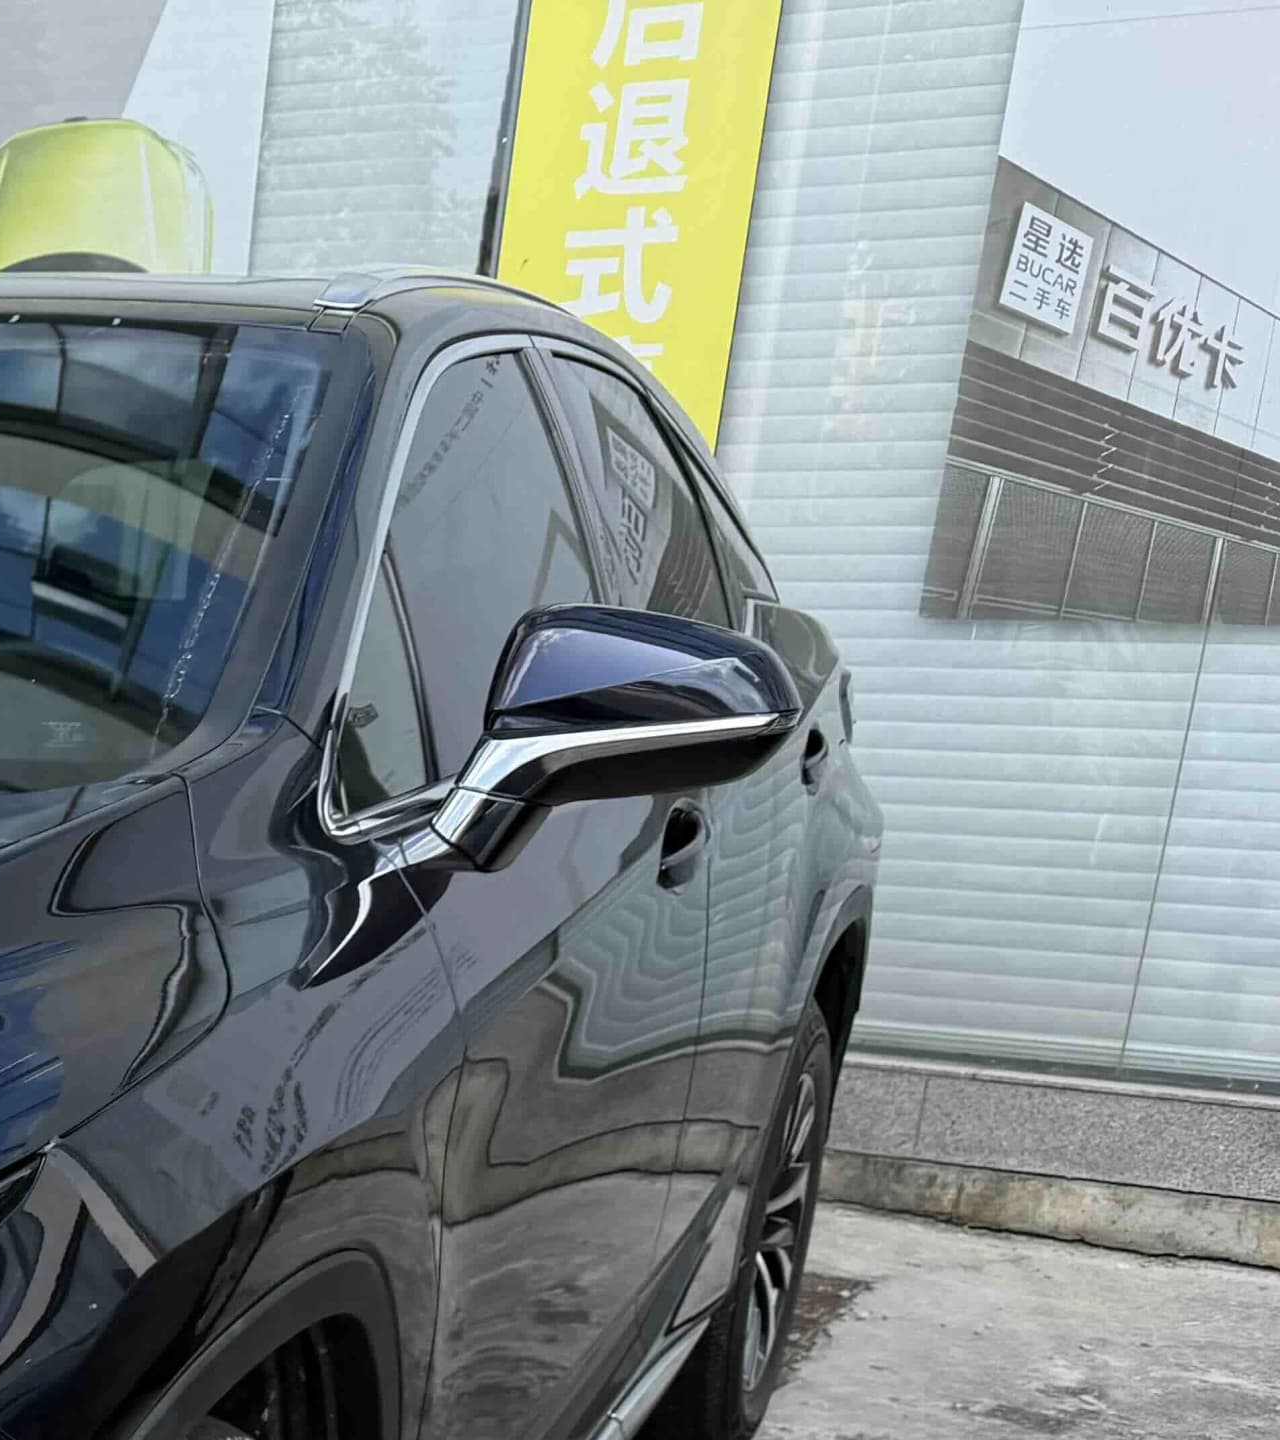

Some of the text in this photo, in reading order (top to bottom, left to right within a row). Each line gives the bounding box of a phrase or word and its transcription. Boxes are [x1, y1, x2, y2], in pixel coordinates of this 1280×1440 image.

[557, 0, 704, 371] 后退式
[1015, 254, 1078, 297] BUCAR
[1021, 215, 1085, 276] 星选
[1008, 279, 1072, 320] 二手车
[1097, 263, 1245, 391] 百优卡
